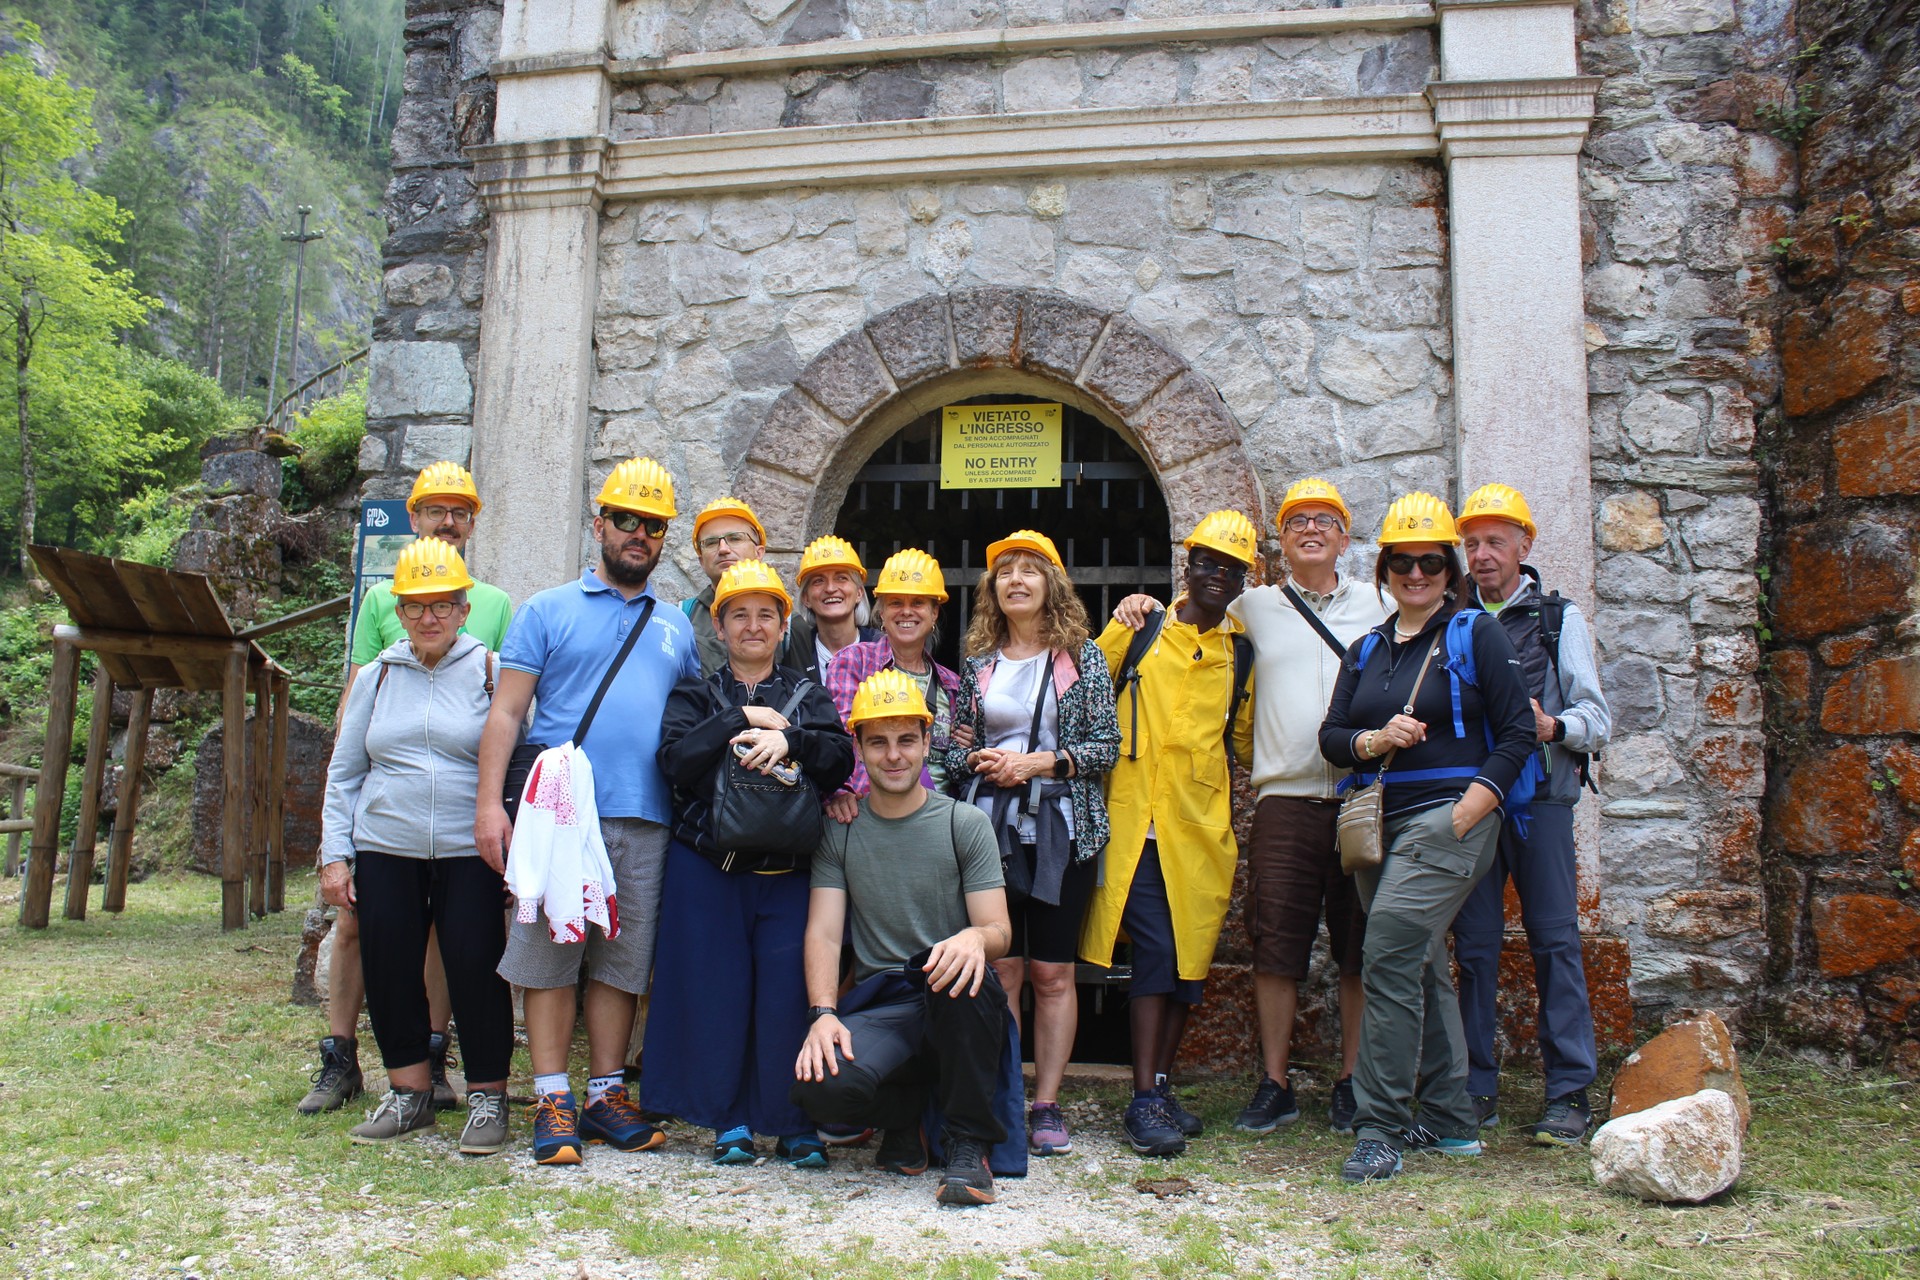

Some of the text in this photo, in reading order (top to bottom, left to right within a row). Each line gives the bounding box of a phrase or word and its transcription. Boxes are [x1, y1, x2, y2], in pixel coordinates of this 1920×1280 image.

[973, 410, 1031, 422] VIETATO
[959, 422, 1044, 435] L'INGRESSO
[965, 457, 1038, 469] NO ENTRY
